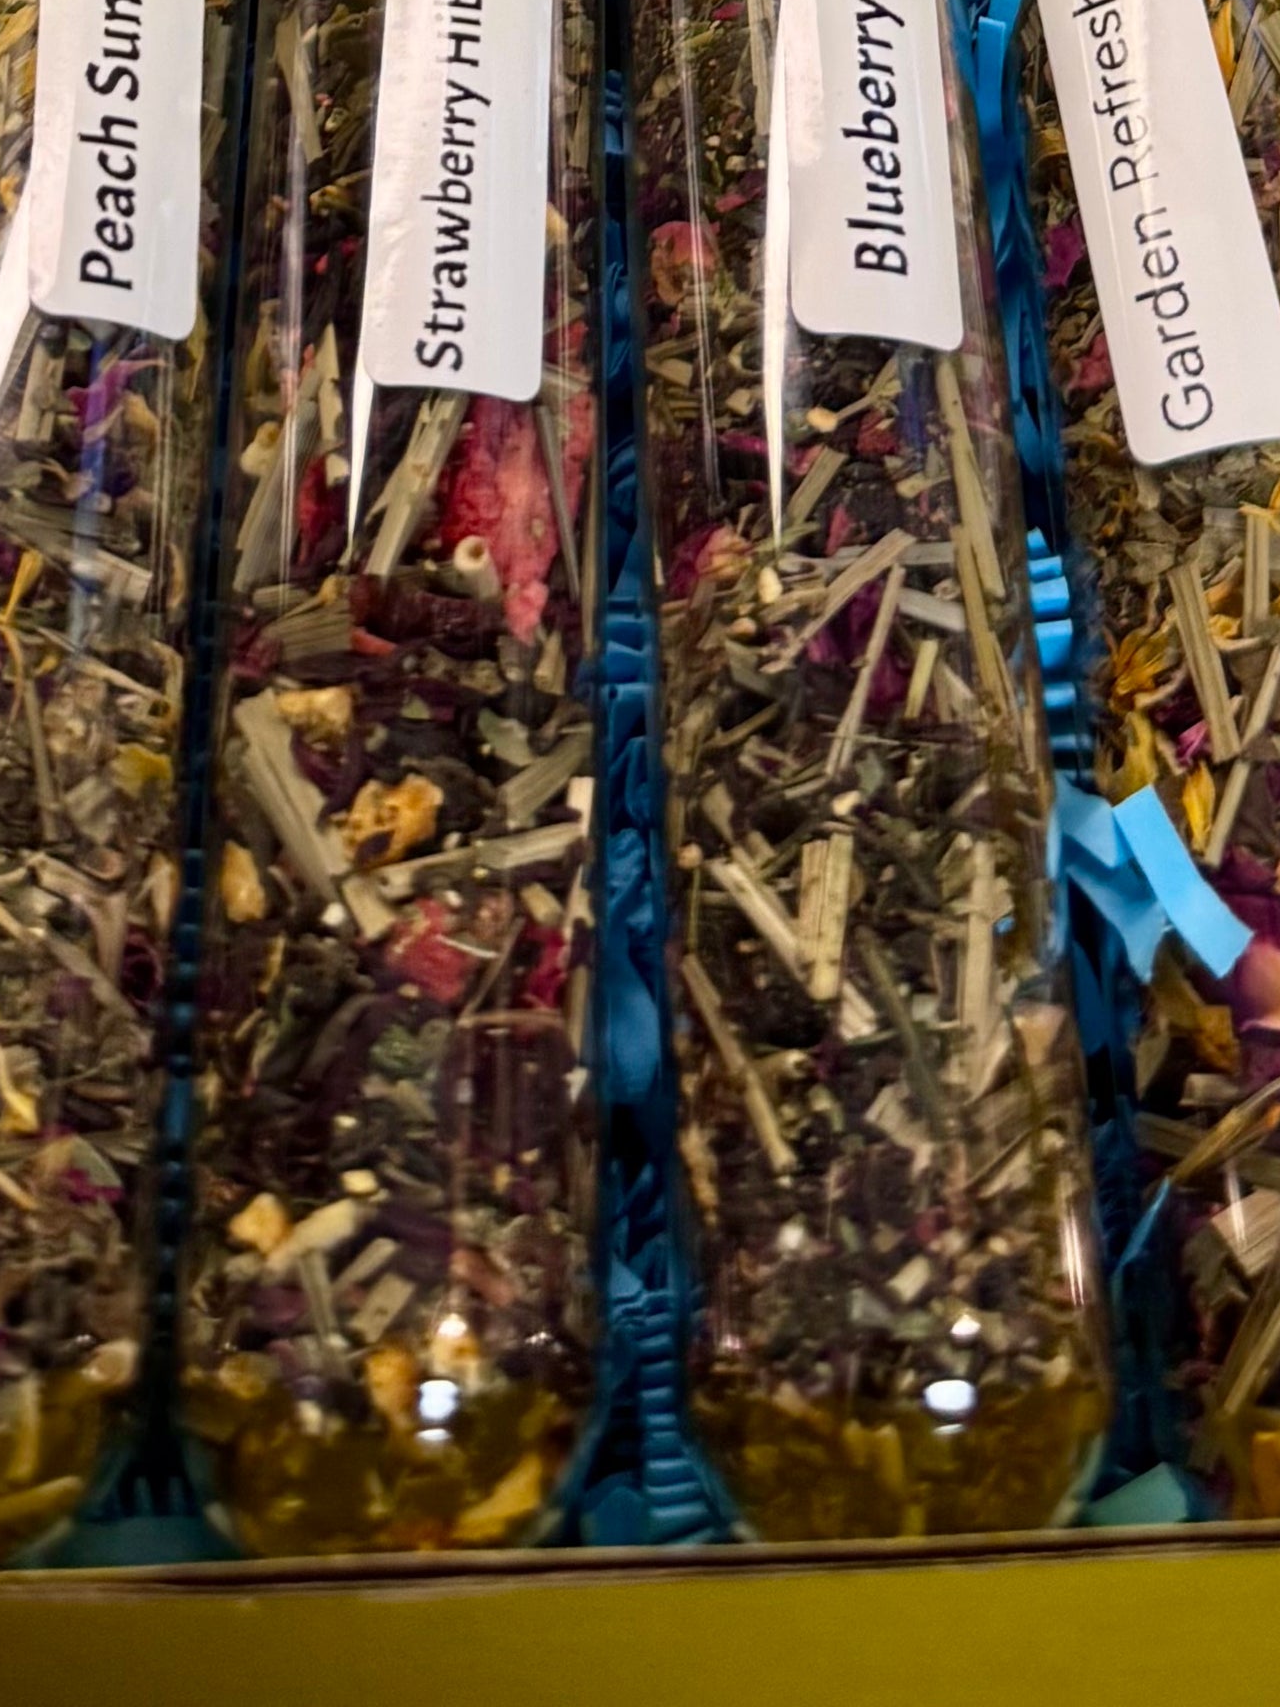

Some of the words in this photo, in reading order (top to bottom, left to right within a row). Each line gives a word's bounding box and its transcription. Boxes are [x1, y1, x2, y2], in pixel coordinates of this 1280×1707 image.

[78, 119, 138, 290] Peach
[416, 83, 491, 371] Strawberry
[1135, 206, 1214, 432] Garden
